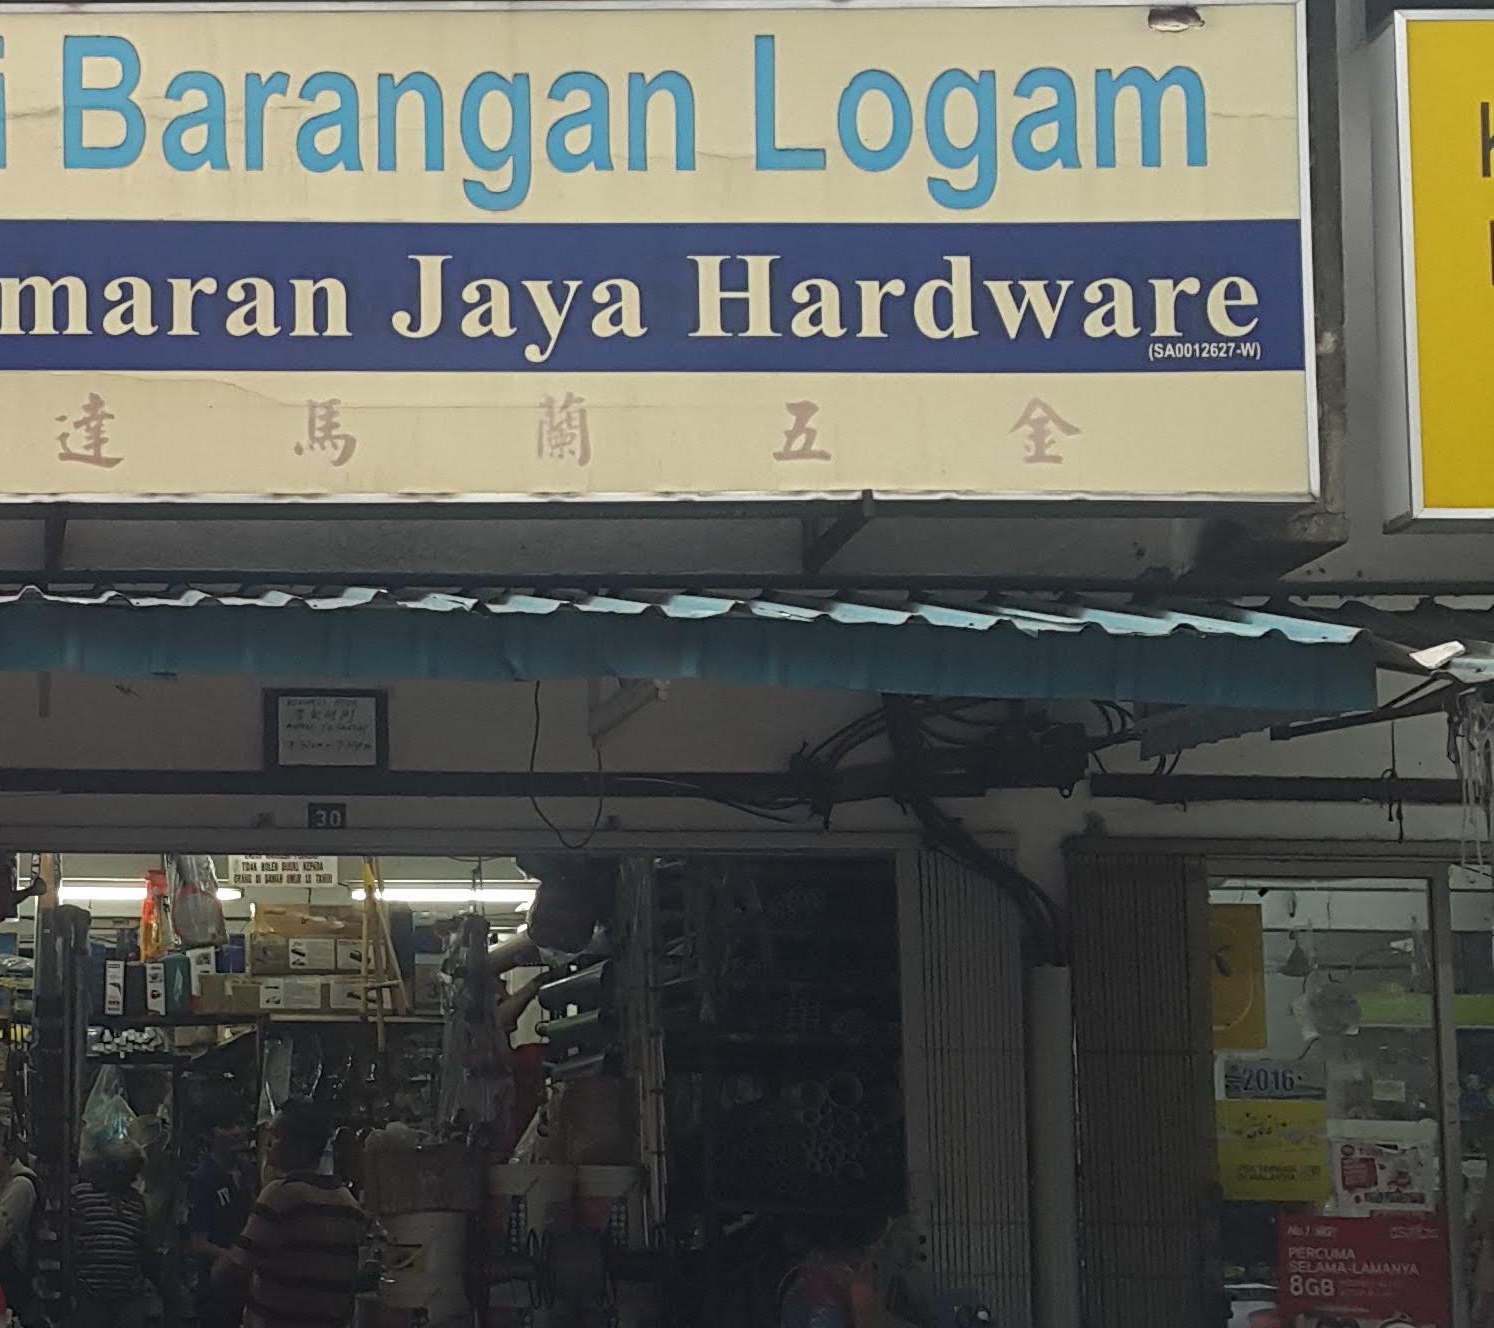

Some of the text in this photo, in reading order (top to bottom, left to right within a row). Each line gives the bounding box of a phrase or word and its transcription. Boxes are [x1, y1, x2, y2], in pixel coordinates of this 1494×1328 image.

[62, 34, 696, 212] Barangan
[753, 34, 1208, 211] Logam
[391, 254, 648, 363] Jaya
[687, 254, 1260, 342] Hardware
[1147, 341, 1262, 362] (SA0012627-W)
[315, 809, 342, 828] 30
[1242, 1068, 1296, 1091] 2016
[1288, 1246, 1357, 1260] PERCUMA
[1288, 1260, 1421, 1276] SELAMA-LAMANYA
[1289, 1274, 1336, 1297] 8GB
